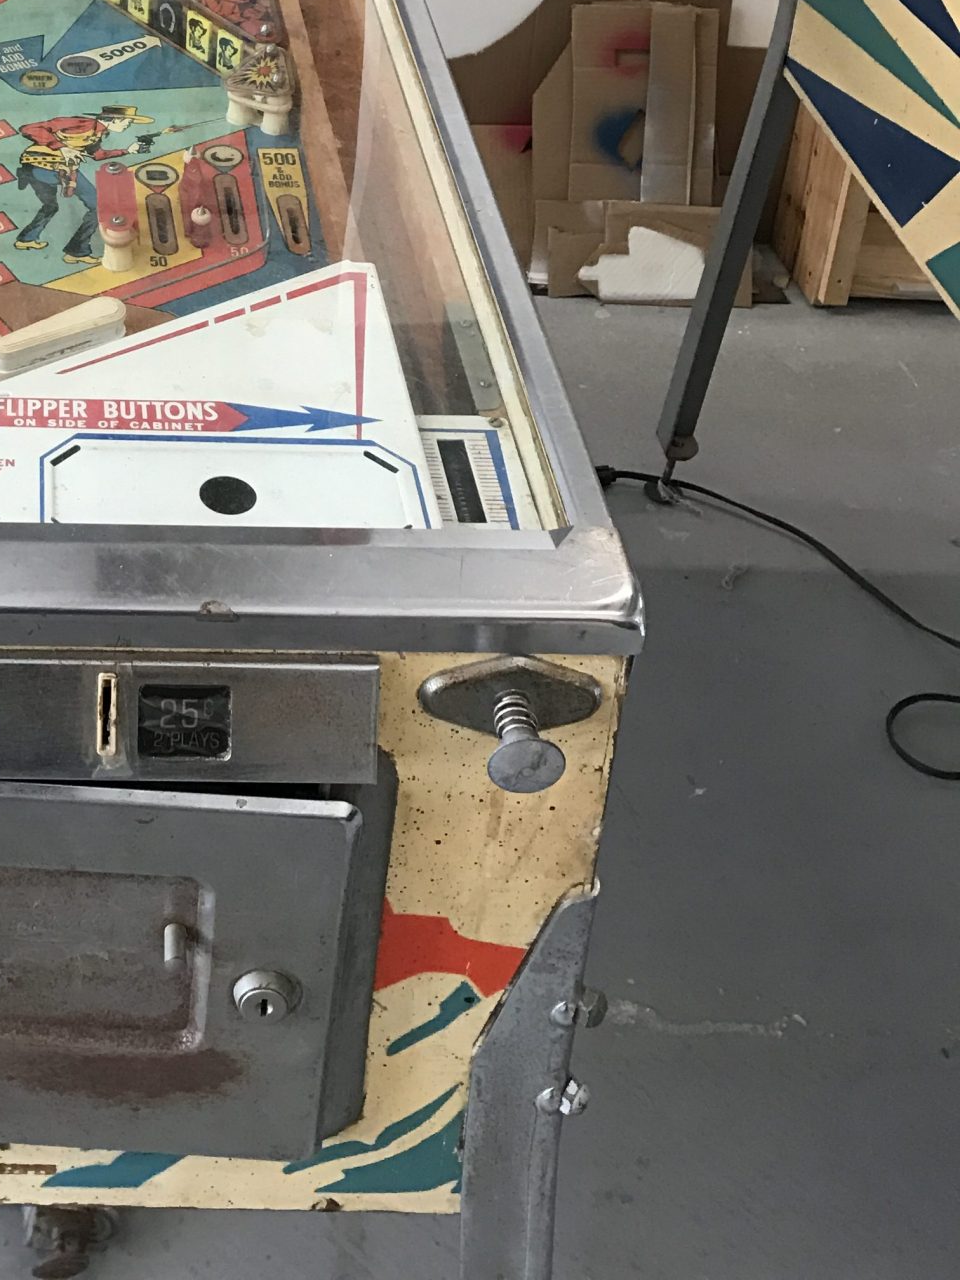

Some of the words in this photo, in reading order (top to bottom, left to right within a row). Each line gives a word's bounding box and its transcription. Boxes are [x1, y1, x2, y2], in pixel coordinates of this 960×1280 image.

[2, 43, 24, 54] and
[98, 40, 148, 62] 5000
[0, 52, 25, 64] ADD
[262, 152, 297, 166] 500
[271, 173, 292, 181] ADD
[268, 180, 301, 189] BONUS
[150, 255, 168, 268] 50
[103, 400, 219, 421] BUTTONS
[13, 417, 37, 427] ON
[47, 418, 87, 428] SIDE
[97, 420, 119, 429] OF
[129, 421, 205, 432] CABINET
[153, 731, 165, 747] 2
[170, 731, 221, 748] PLAYS
